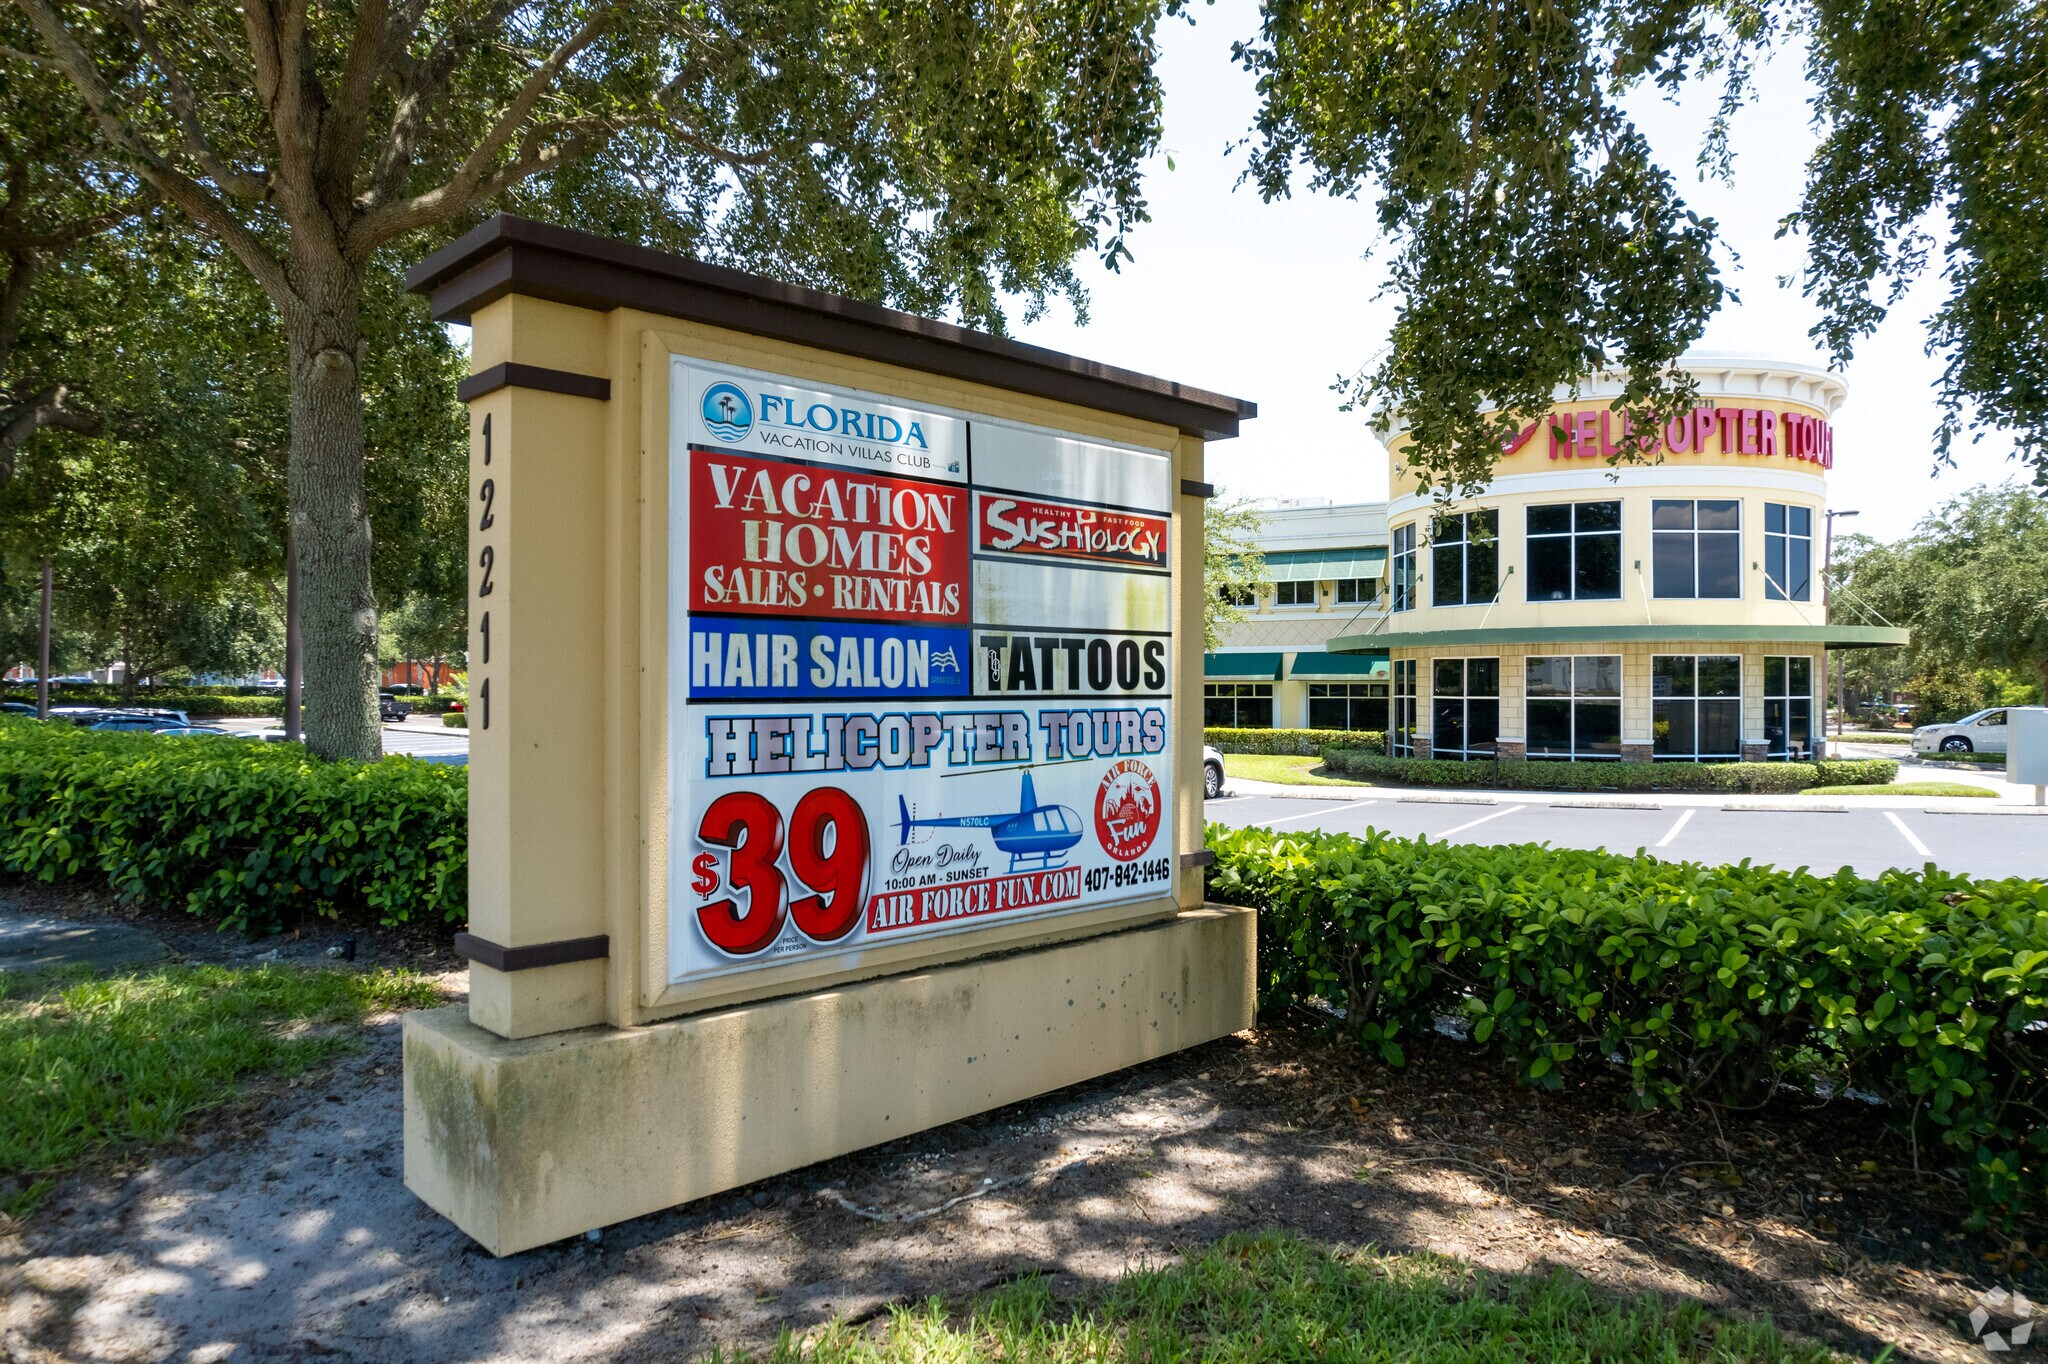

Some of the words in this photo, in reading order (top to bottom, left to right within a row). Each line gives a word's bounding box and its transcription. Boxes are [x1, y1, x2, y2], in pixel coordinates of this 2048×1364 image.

[759, 393, 928, 448] FLORIDA
[760, 431, 843, 455] VACATION
[848, 445, 892, 463] VILLAS
[897, 453, 931, 468] CLUB
[1781, 412, 1833, 469] TOUR
[708, 463, 955, 533] VACATION
[1032, 507, 1071, 518] HEALTHY
[1103, 516, 1122, 525] FAST
[1125, 519, 1145, 527] FOOD
[741, 519, 932, 576] HOMES
[479, 412, 495, 730] 12211
[704, 565, 808, 608] SALES
[829, 574, 960, 616] RENTALS
[693, 632, 798, 687] HAIR
[810, 635, 929, 688] SALON
[980, 635, 1166, 691] TATTOOS
[705, 710, 1032, 778] HELICOPTER
[1039, 707, 1165, 760] TOURS
[1101, 764, 1120, 792] AIR
[1123, 759, 1157, 788] FORCE
[960, 817, 989, 827] N570LC
[1106, 818, 1147, 847] Fun
[892, 847, 934, 874] Open
[936, 843, 982, 868] Daily
[1107, 841, 1148, 857] ORLANDO
[885, 876, 915, 891] 10:00
[919, 874, 936, 886] AM
[946, 867, 989, 882] SUNSET
[1085, 858, 1170, 892] 407-842-1446
[871, 895, 914, 930] AIR
[920, 883, 990, 922] FORCE
[994, 869, 1080, 909] FUN.COM
[773, 946, 784, 954] PER
[785, 943, 807, 951] PERSON
[783, 936, 798, 944] PRICE
